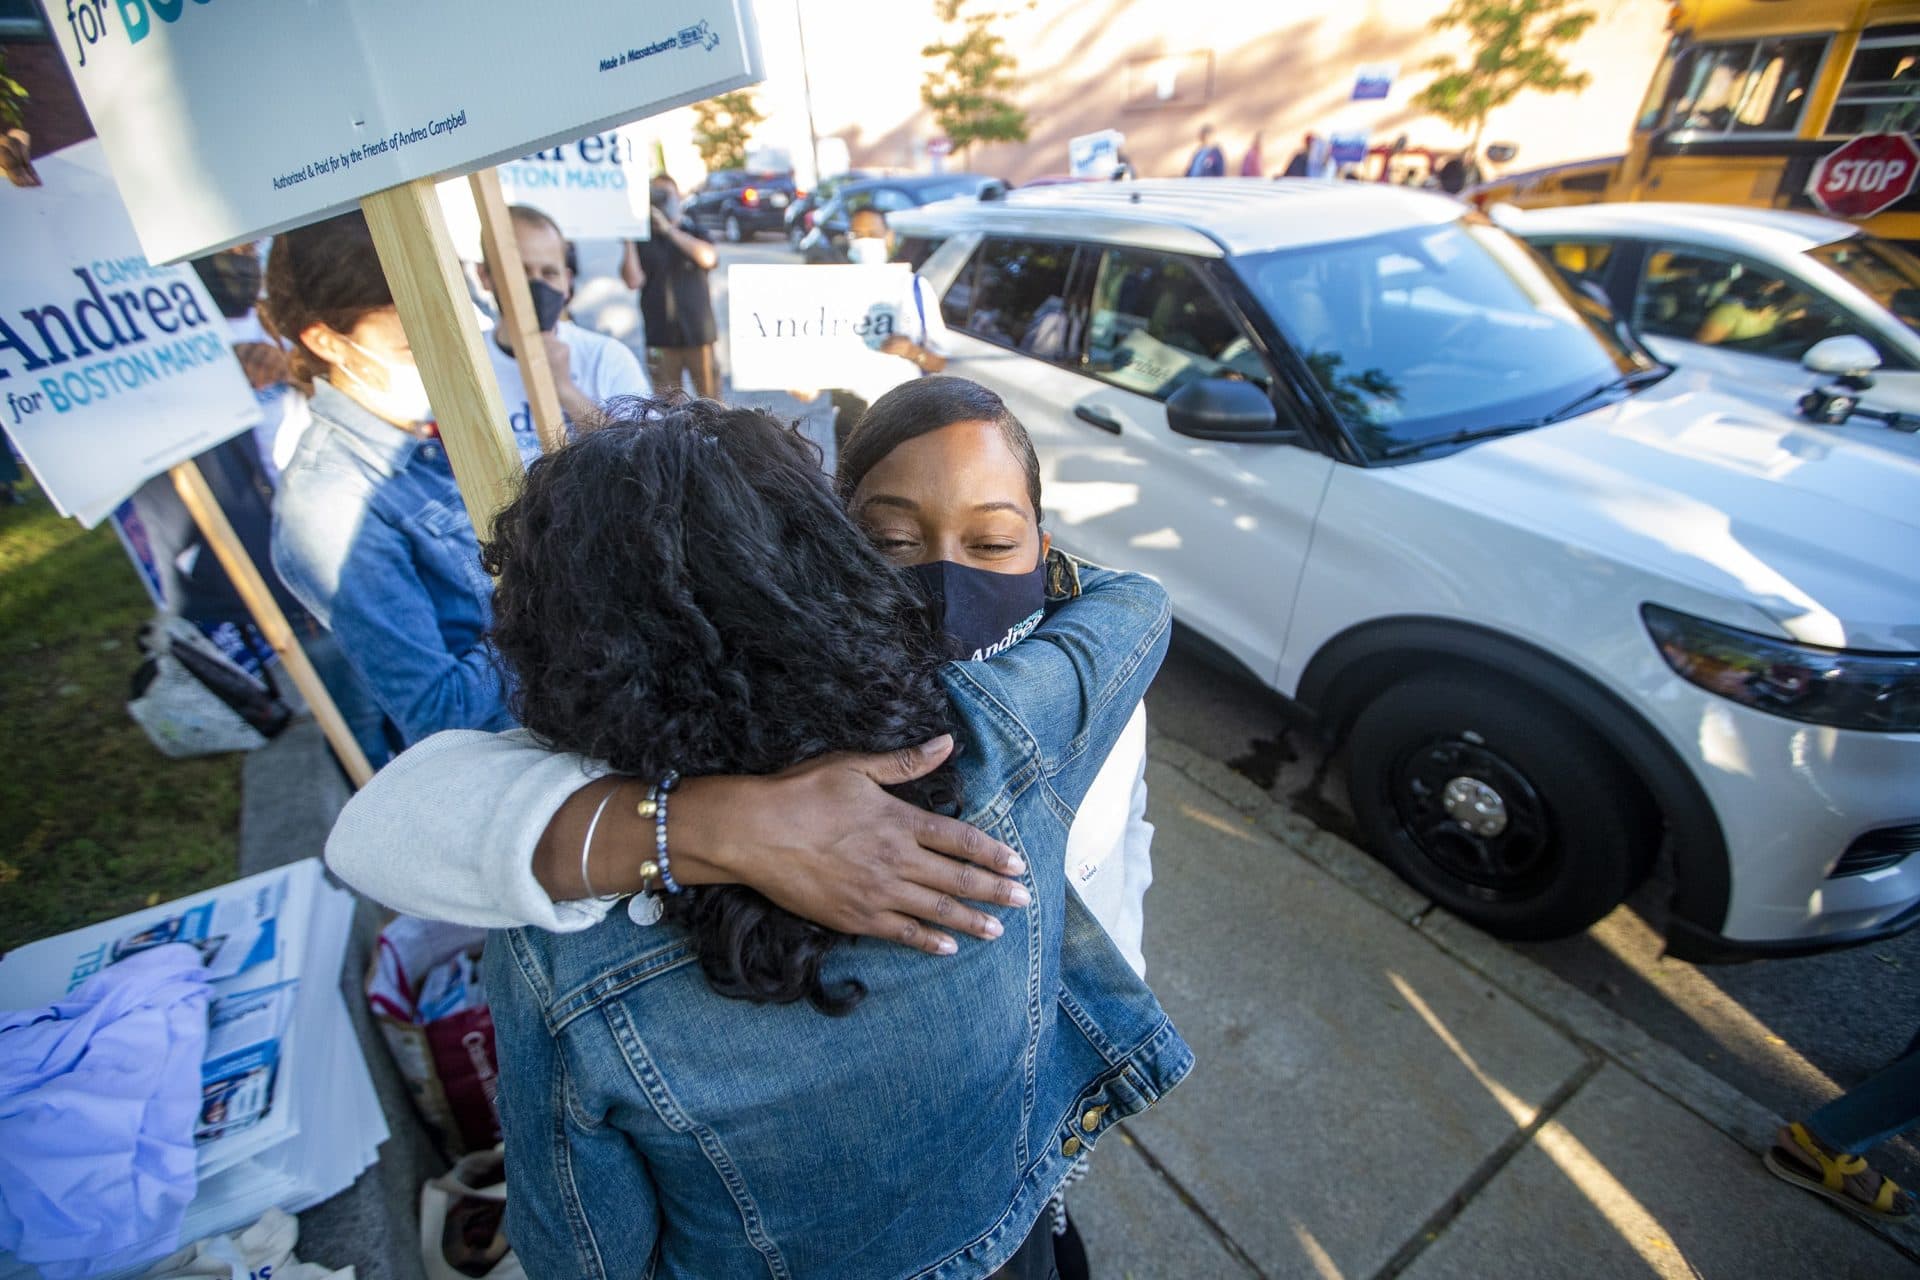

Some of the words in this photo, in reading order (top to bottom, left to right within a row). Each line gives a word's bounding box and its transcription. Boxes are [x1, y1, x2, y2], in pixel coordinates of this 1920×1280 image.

[66, 0, 108, 67] for
[599, 56, 618, 72] Made
[619, 53, 626, 65] in
[627, 37, 677, 62] Massachusetts
[273, 168, 307, 191] Authorized
[307, 164, 316, 178] &
[314, 158, 330, 176] Paid
[330, 156, 340, 174] for
[340, 153, 350, 170] by
[350, 148, 362, 163] the
[362, 138, 388, 159] Friends
[389, 132, 399, 151] of
[399, 128, 428, 146] Andrea
[428, 109, 468, 135] Campbell
[1824, 160, 1908, 192] STOP
[7, 391, 44, 424] for
[39, 351, 162, 414] BOSTON
